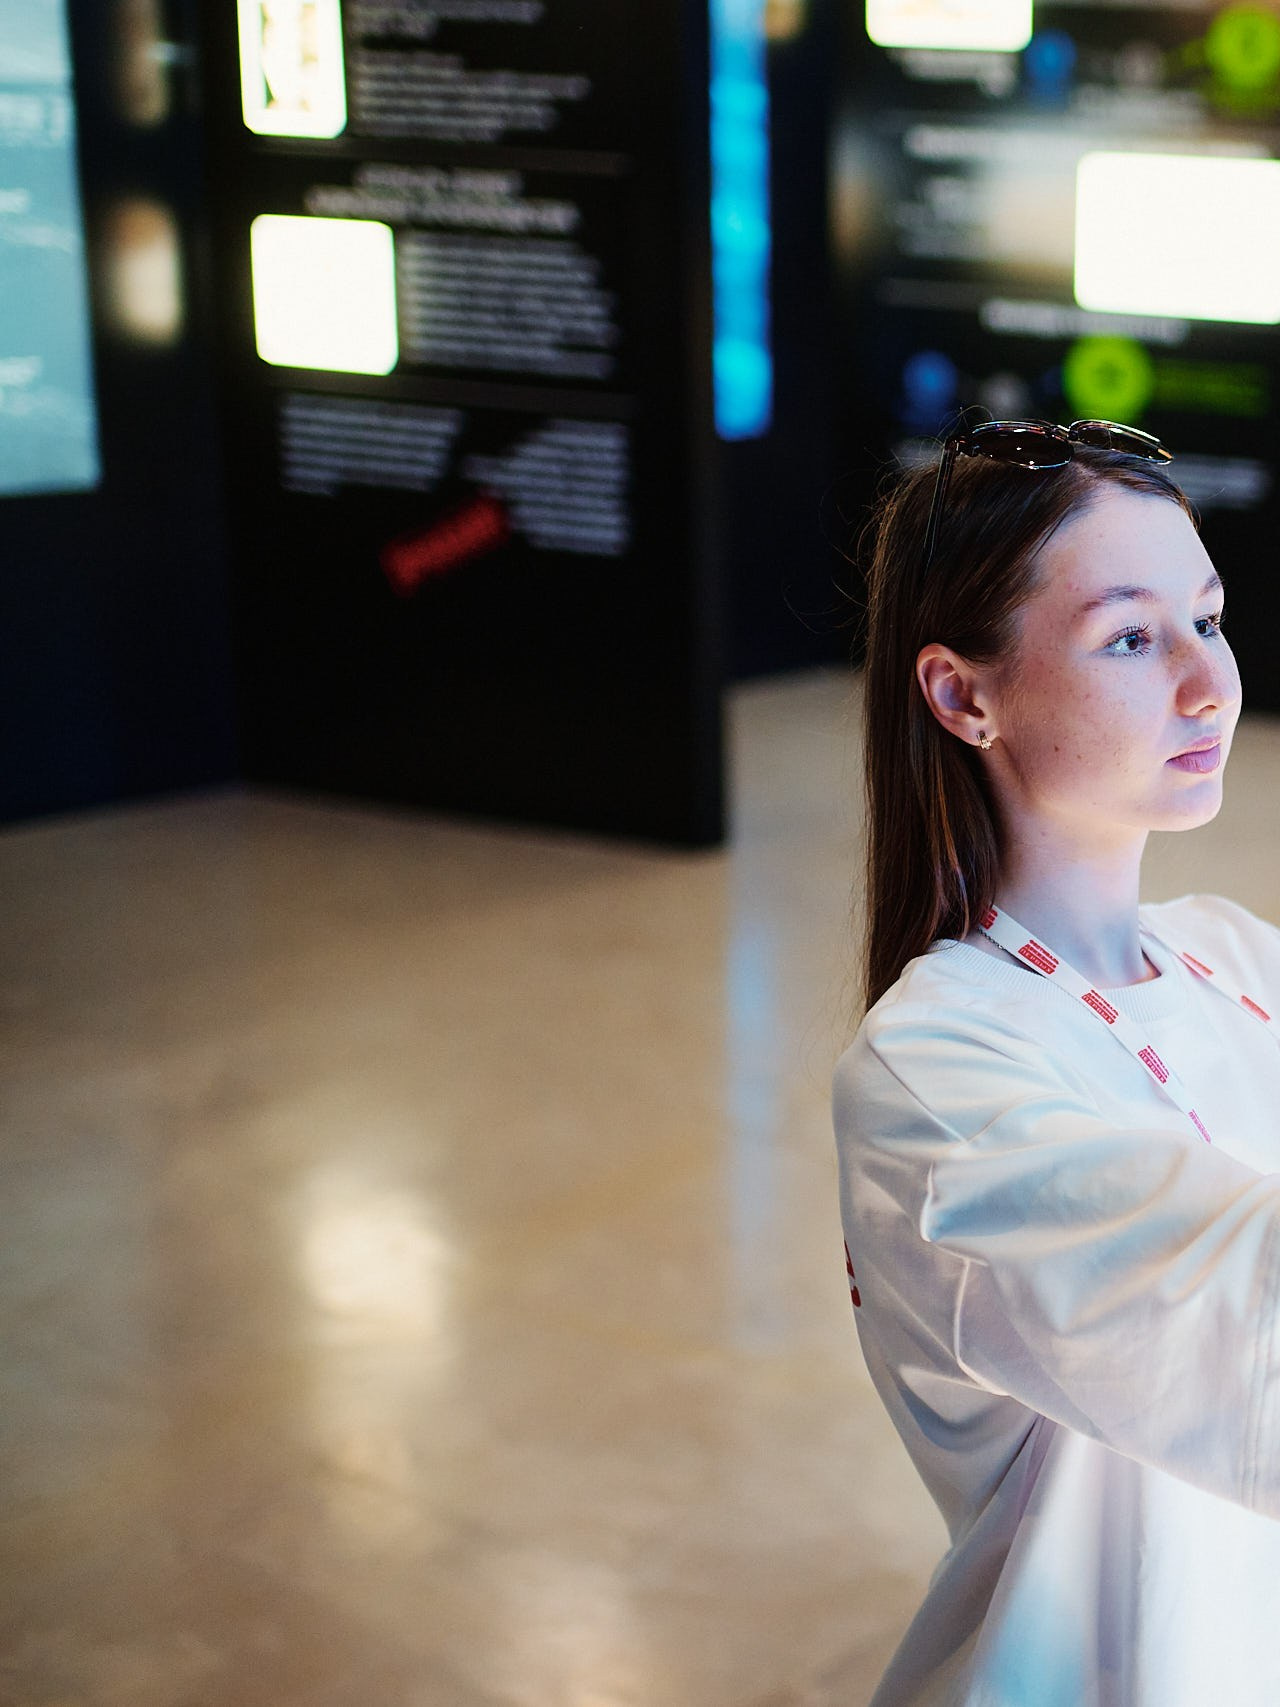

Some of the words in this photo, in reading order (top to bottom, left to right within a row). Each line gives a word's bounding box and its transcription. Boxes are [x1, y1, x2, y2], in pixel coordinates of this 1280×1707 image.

[1018, 946, 1055, 975] ПЕРВЫХ
[1081, 994, 1115, 1024] ПЕРВЫХ
[1137, 1050, 1167, 1084] ПЕРВЫХ
